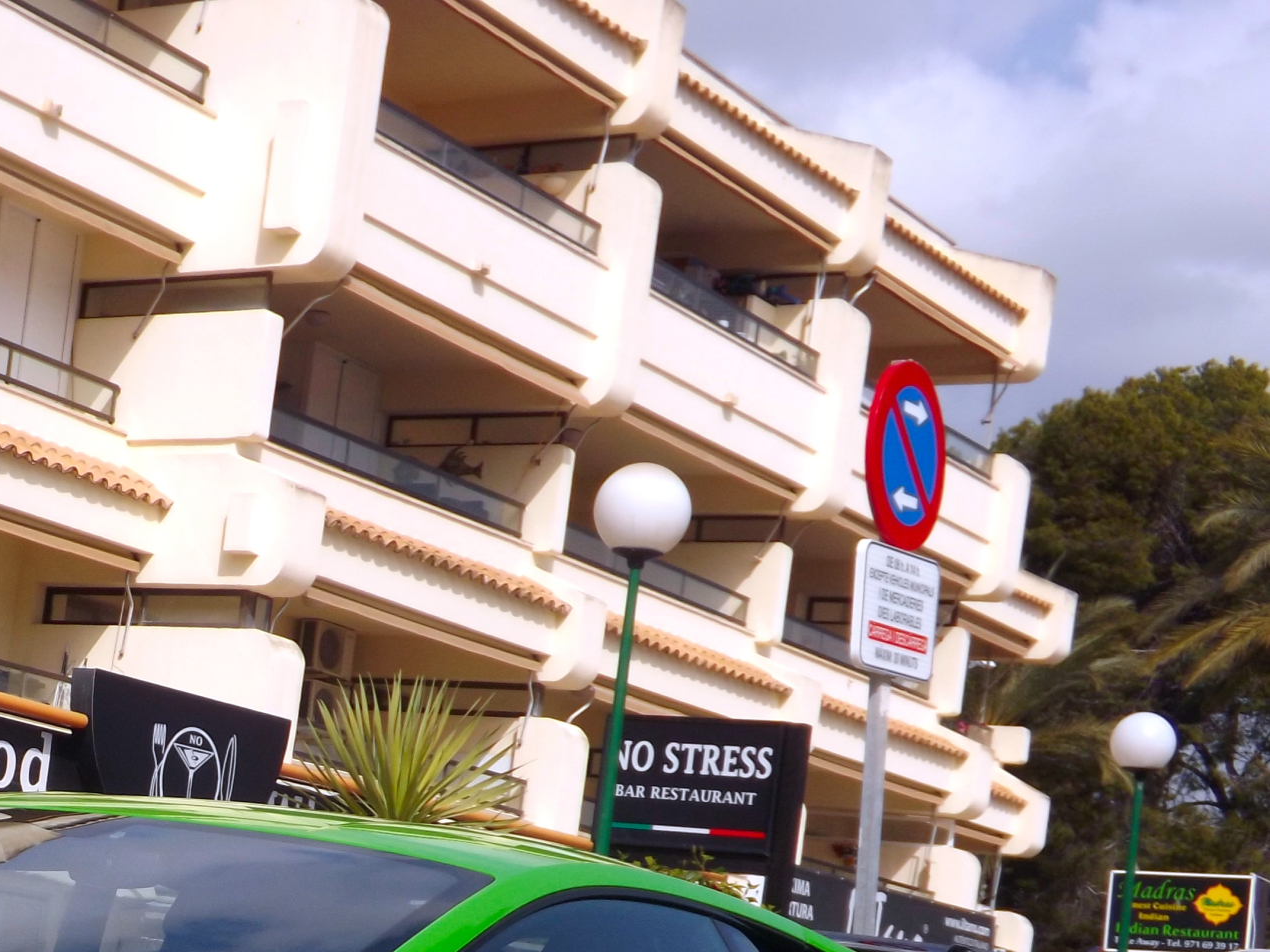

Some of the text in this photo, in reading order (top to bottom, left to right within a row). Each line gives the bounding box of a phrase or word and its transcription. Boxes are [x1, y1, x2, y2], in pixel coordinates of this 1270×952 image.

[189, 734, 203, 747] NO
[618, 740, 774, 780] NO STRESS
[615, 783, 757, 806] BAR RESTAURANT
[1138, 913, 1169, 921] Indian
[1162, 924, 1240, 941] Restaurant
